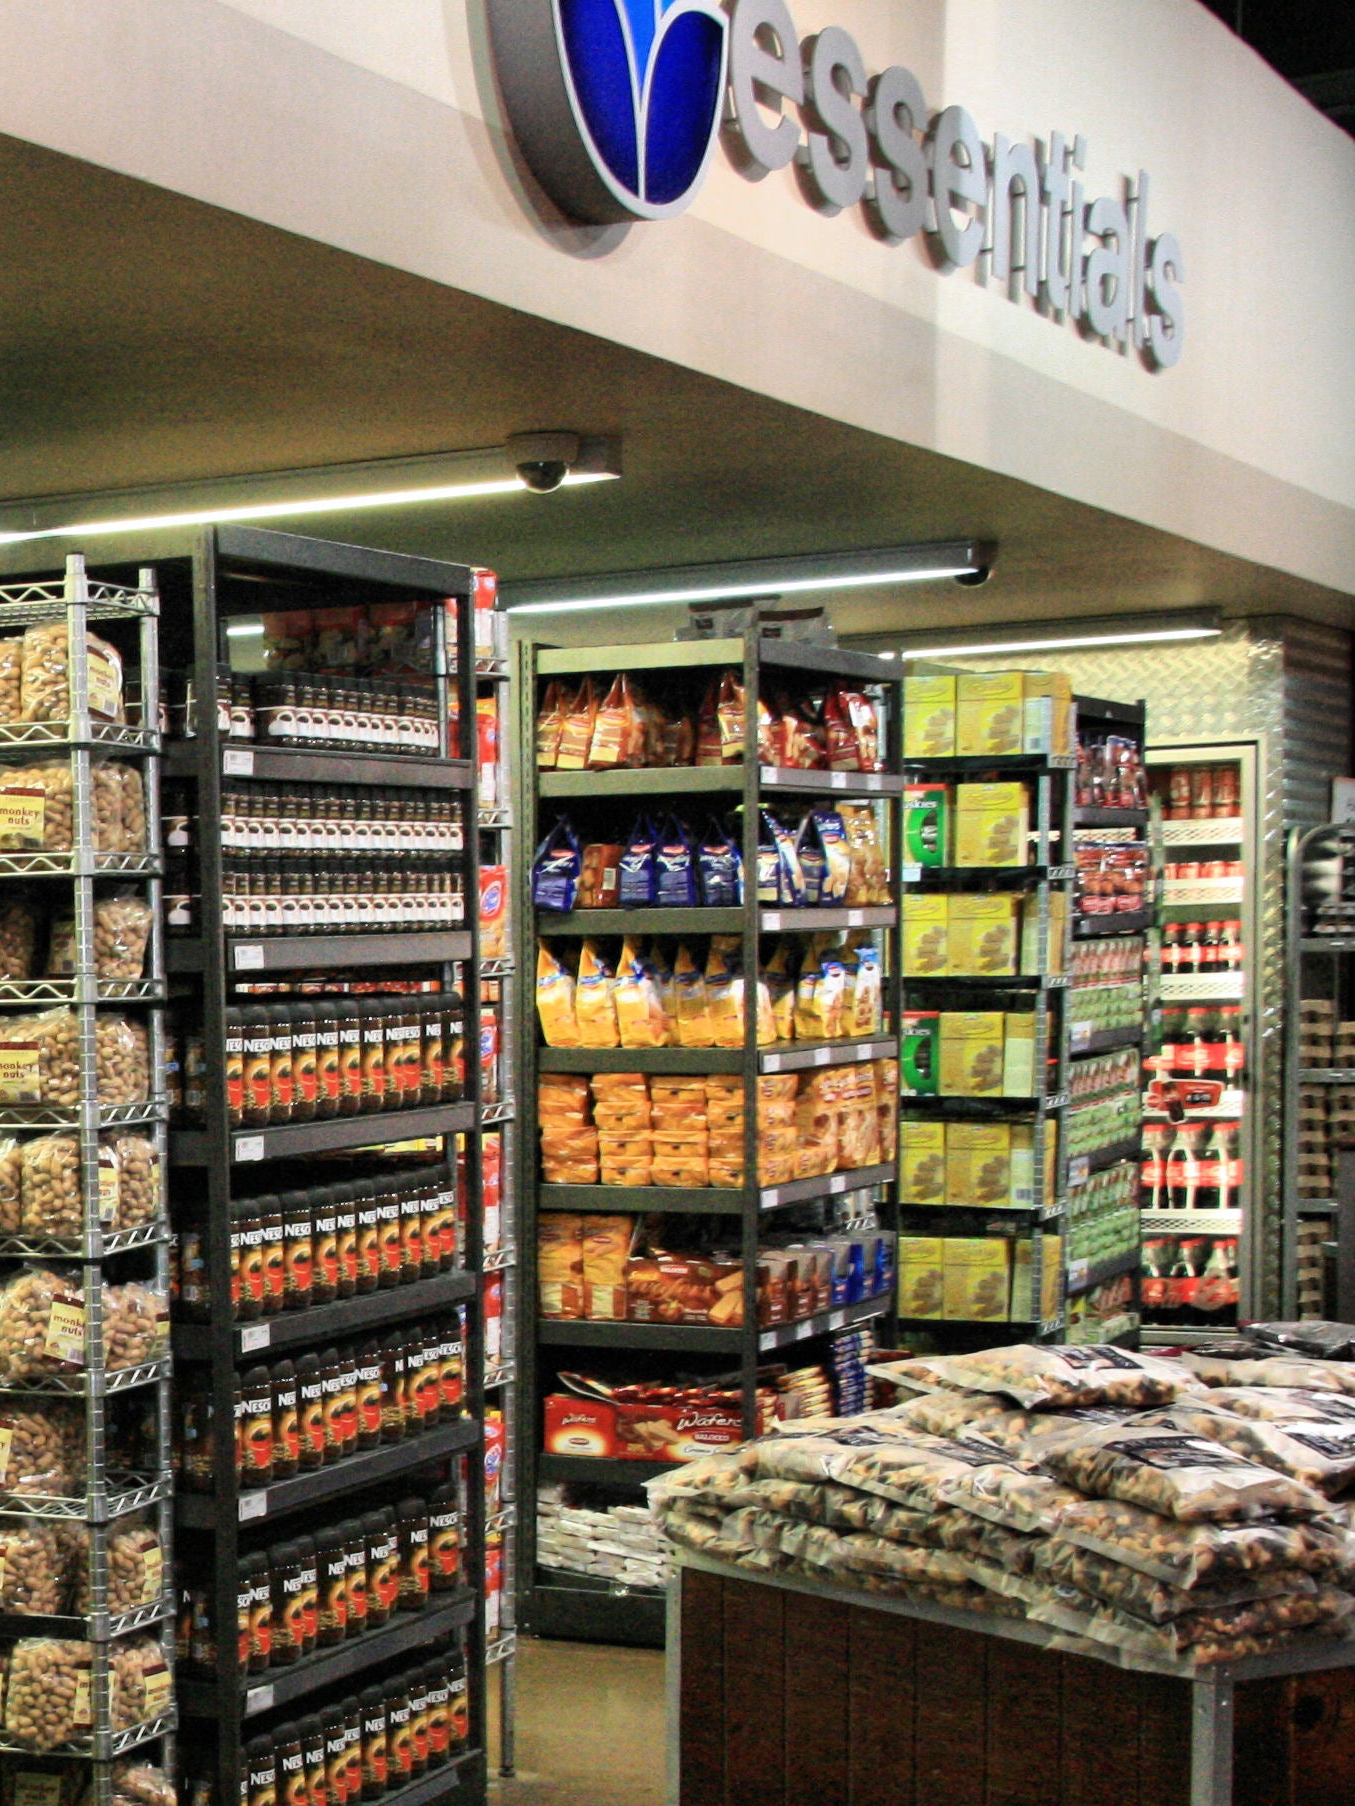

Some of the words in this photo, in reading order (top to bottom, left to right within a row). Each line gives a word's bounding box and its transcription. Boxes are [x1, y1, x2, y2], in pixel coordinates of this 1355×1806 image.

[723, 0, 1185, 370] essentials
[7, 816, 31, 826] nuts
[54, 1314, 85, 1329] monk
